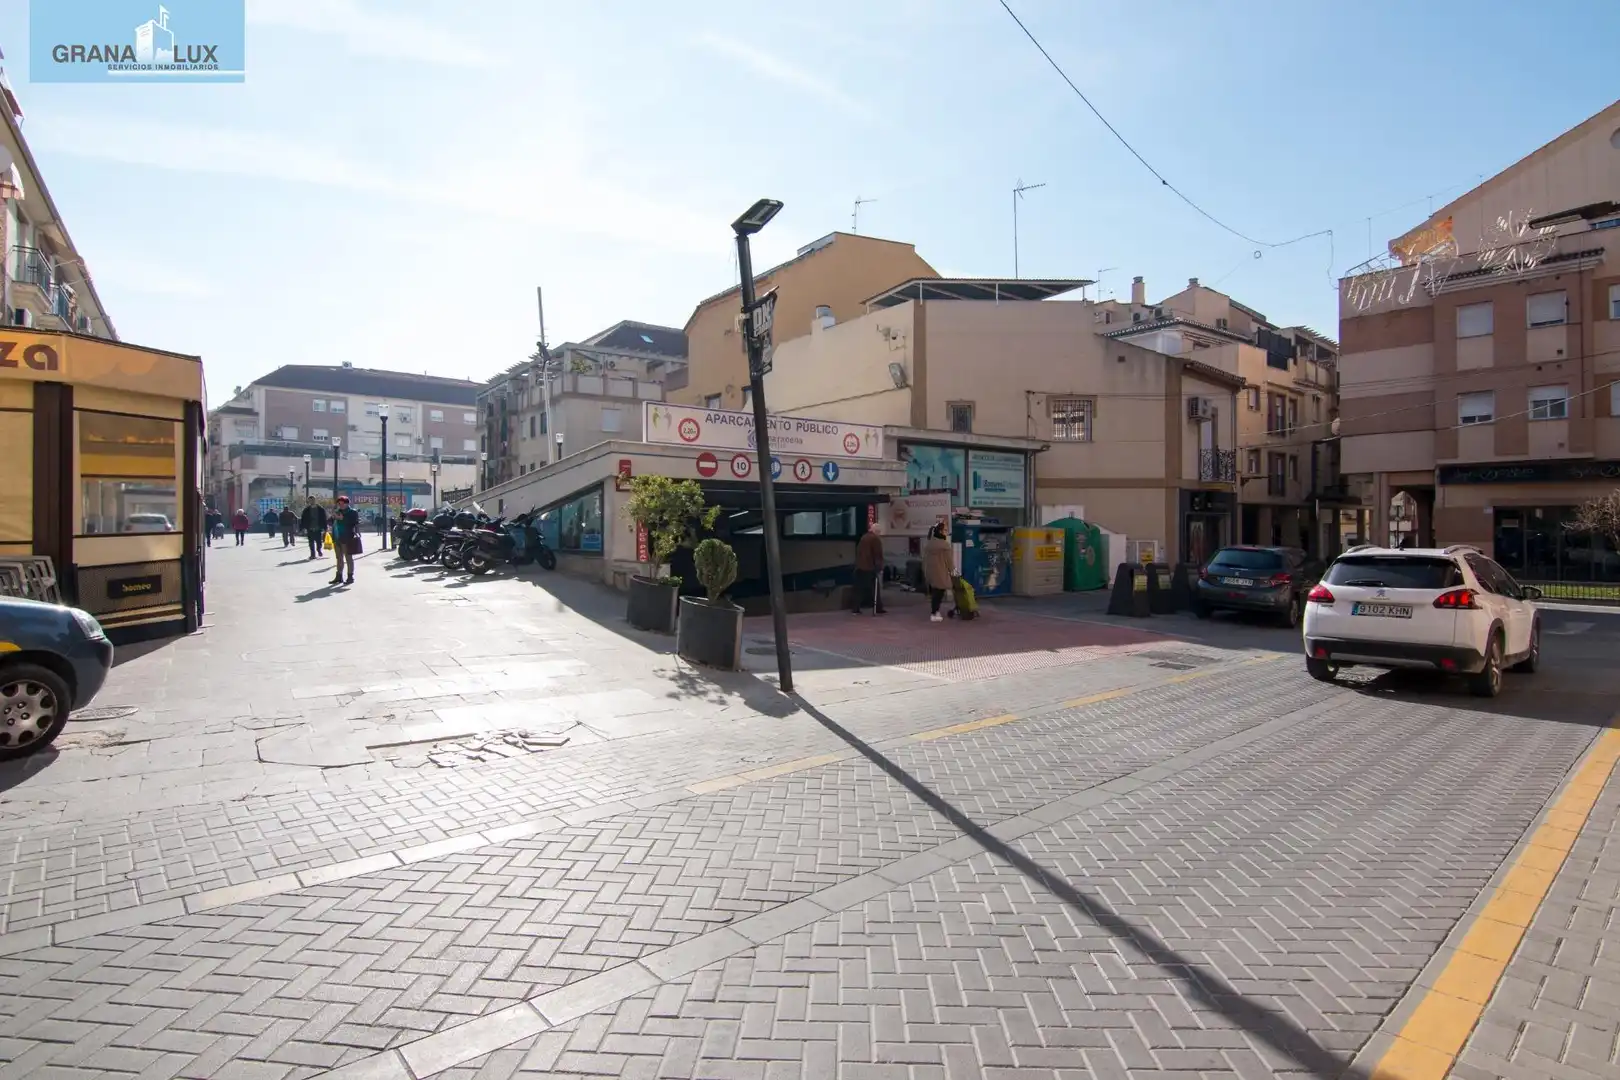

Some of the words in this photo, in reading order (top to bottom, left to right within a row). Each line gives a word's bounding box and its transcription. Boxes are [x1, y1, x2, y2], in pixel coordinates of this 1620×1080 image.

[705, 413, 791, 431] APARCAENTO
[796, 419, 839, 435] PÚBLICO
[736, 462, 747, 471] 10
[1359, 605, 1386, 614] 9102
[1388, 606, 1410, 616] KHN
